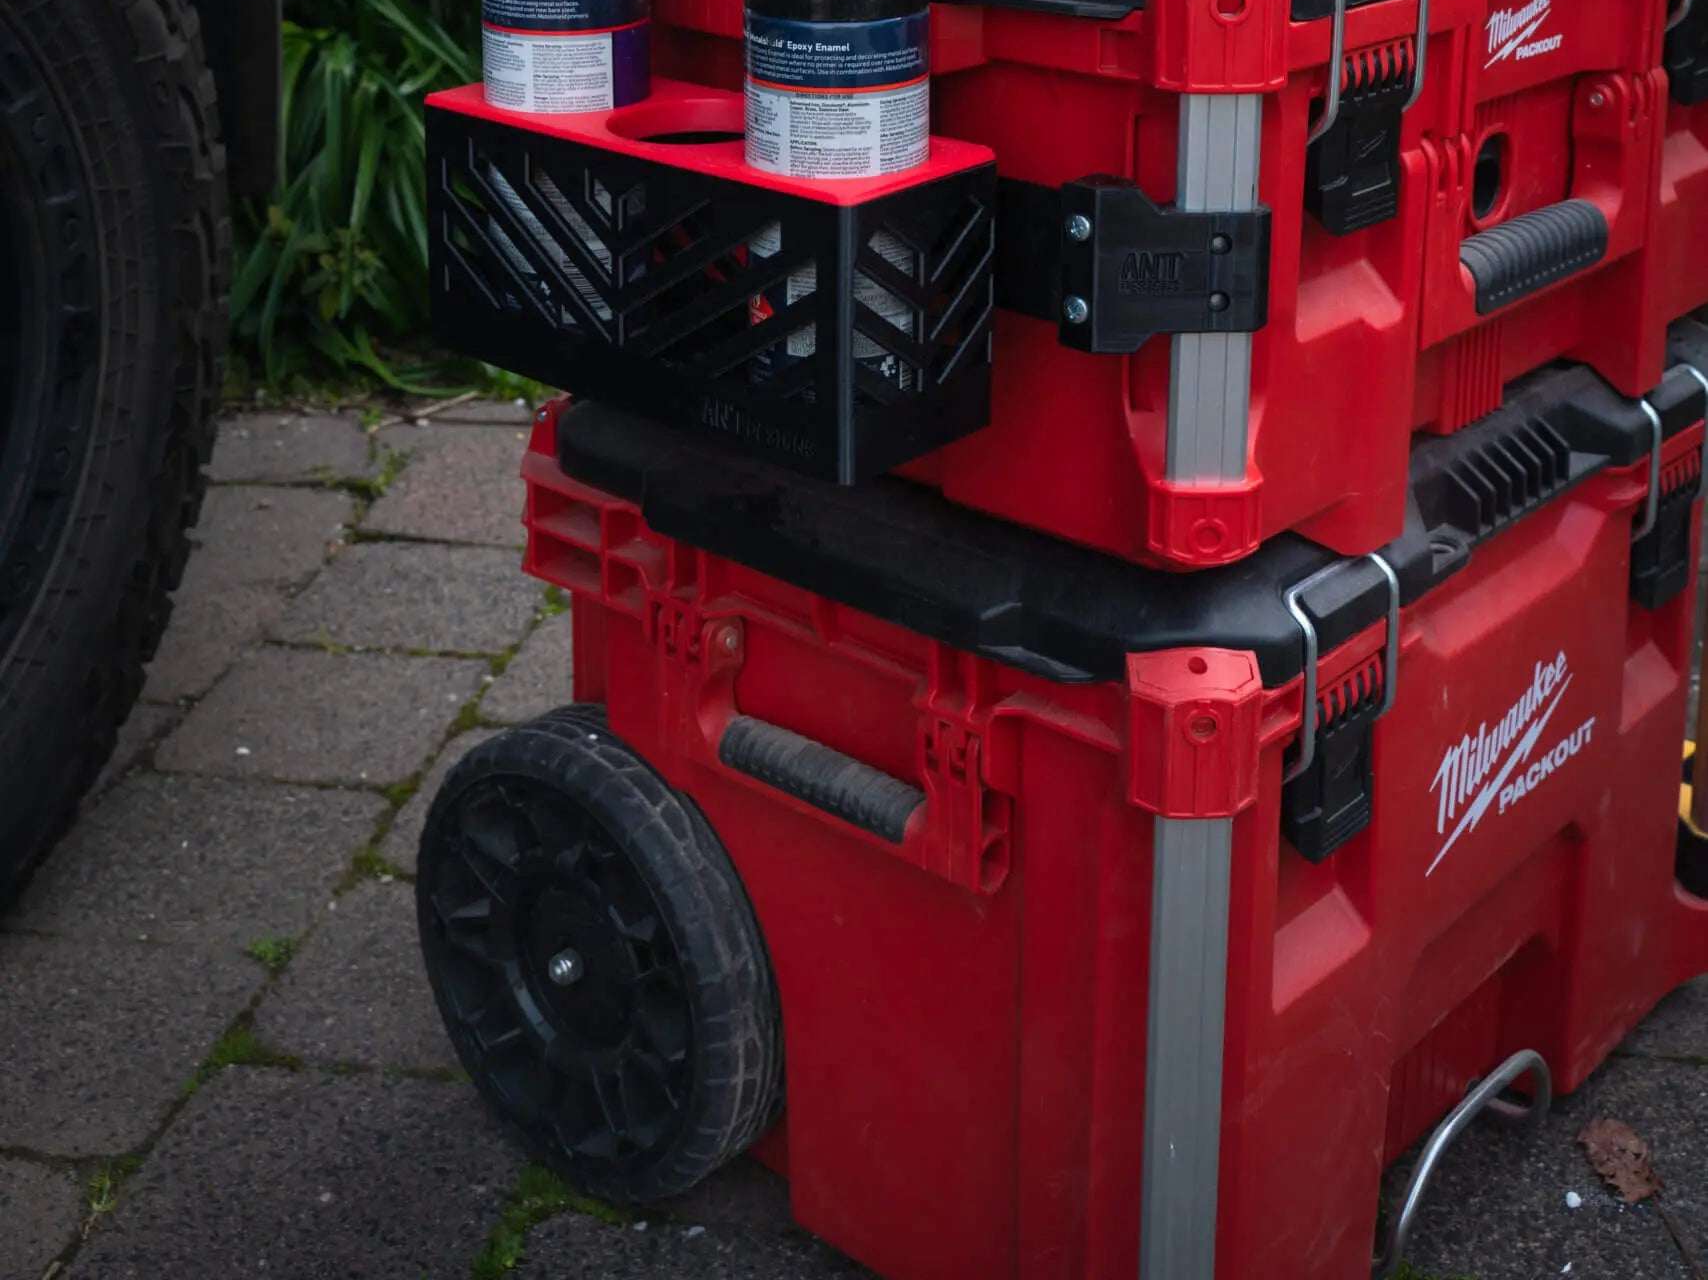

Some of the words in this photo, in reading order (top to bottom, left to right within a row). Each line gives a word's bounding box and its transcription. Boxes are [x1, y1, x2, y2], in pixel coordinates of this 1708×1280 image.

[787, 41, 813, 52] Epoxy
[816, 43, 850, 52] Enamel
[1516, 34, 1563, 60] PACKOUT
[1429, 649, 1568, 834] Milwaukee
[1498, 716, 1596, 815] PACKOUT
